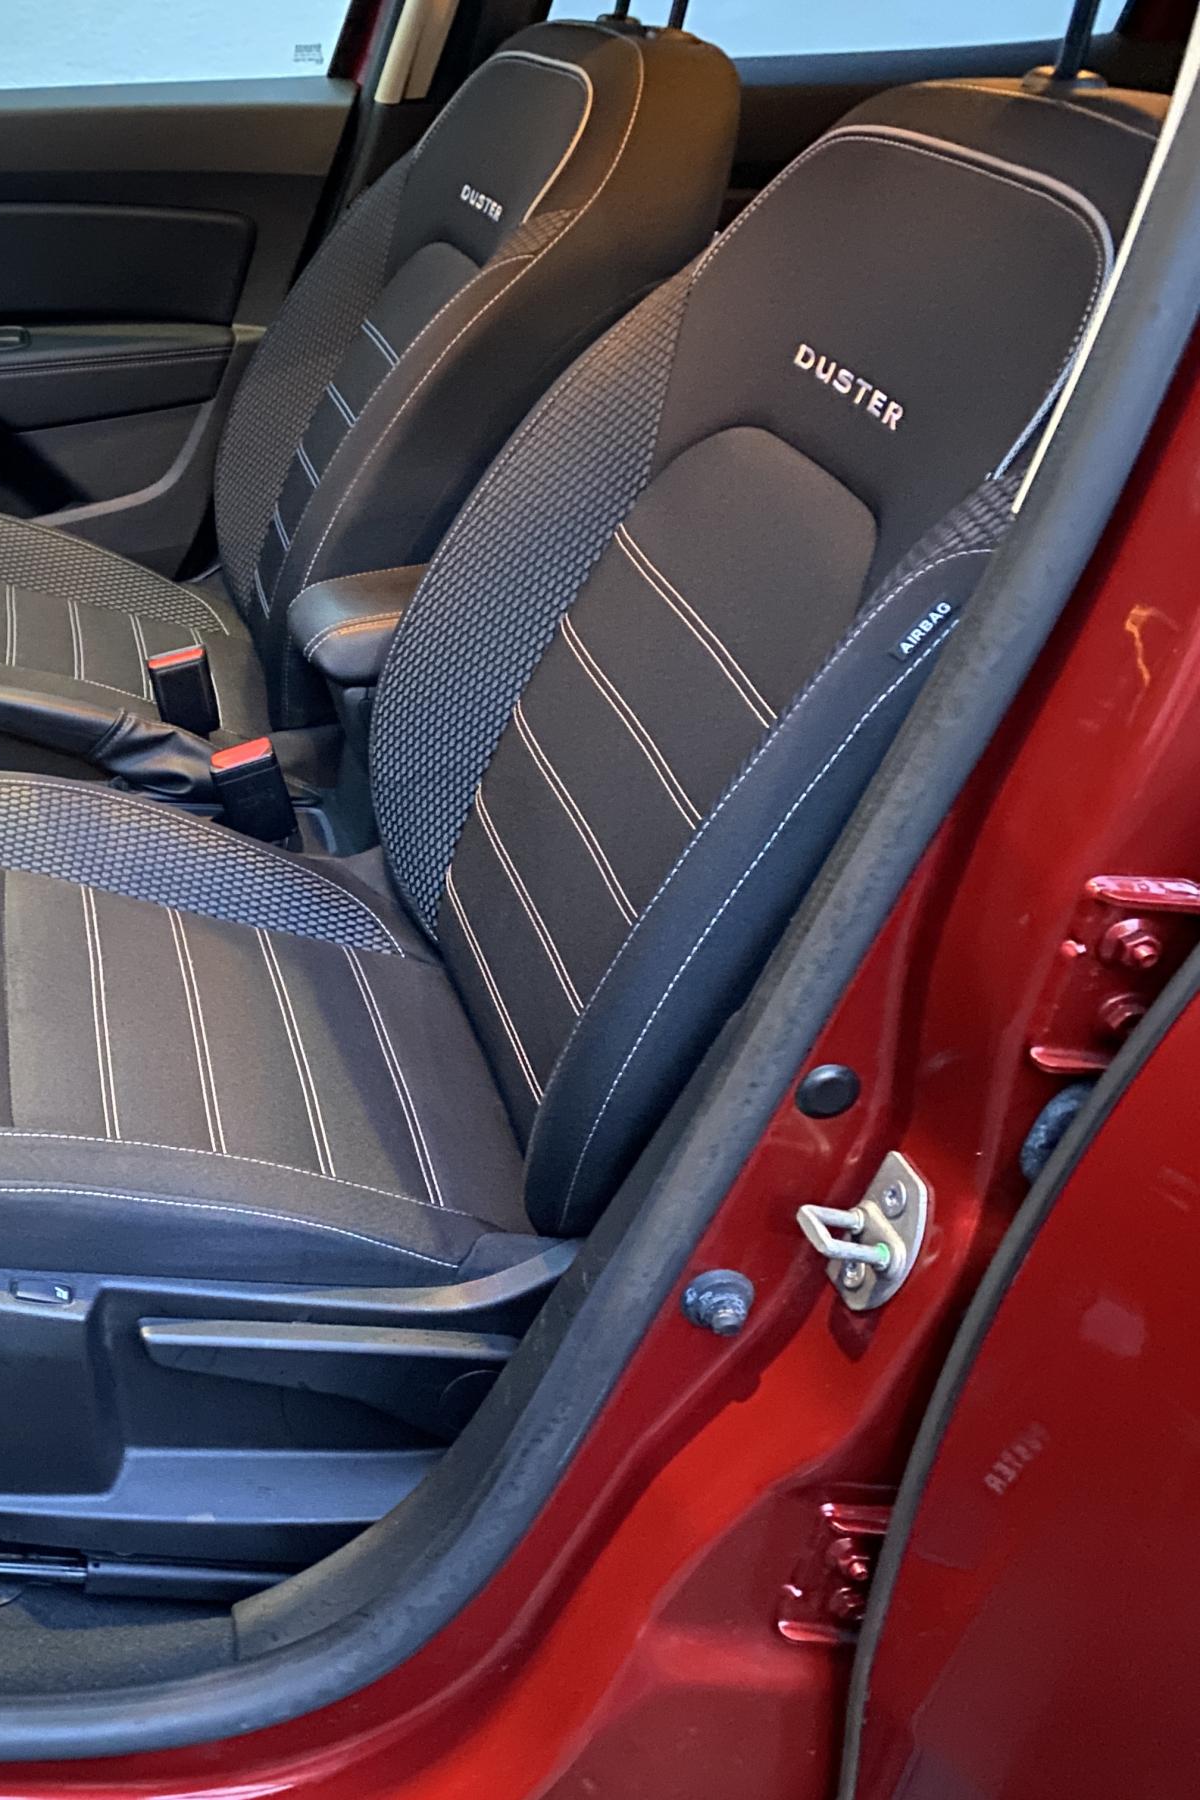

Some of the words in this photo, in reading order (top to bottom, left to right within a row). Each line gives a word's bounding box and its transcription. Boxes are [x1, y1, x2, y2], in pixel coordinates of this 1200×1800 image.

[460, 184, 503, 222] DUSTER
[793, 343, 904, 431] DUSTER
[900, 602, 951, 654] AIRBAG
